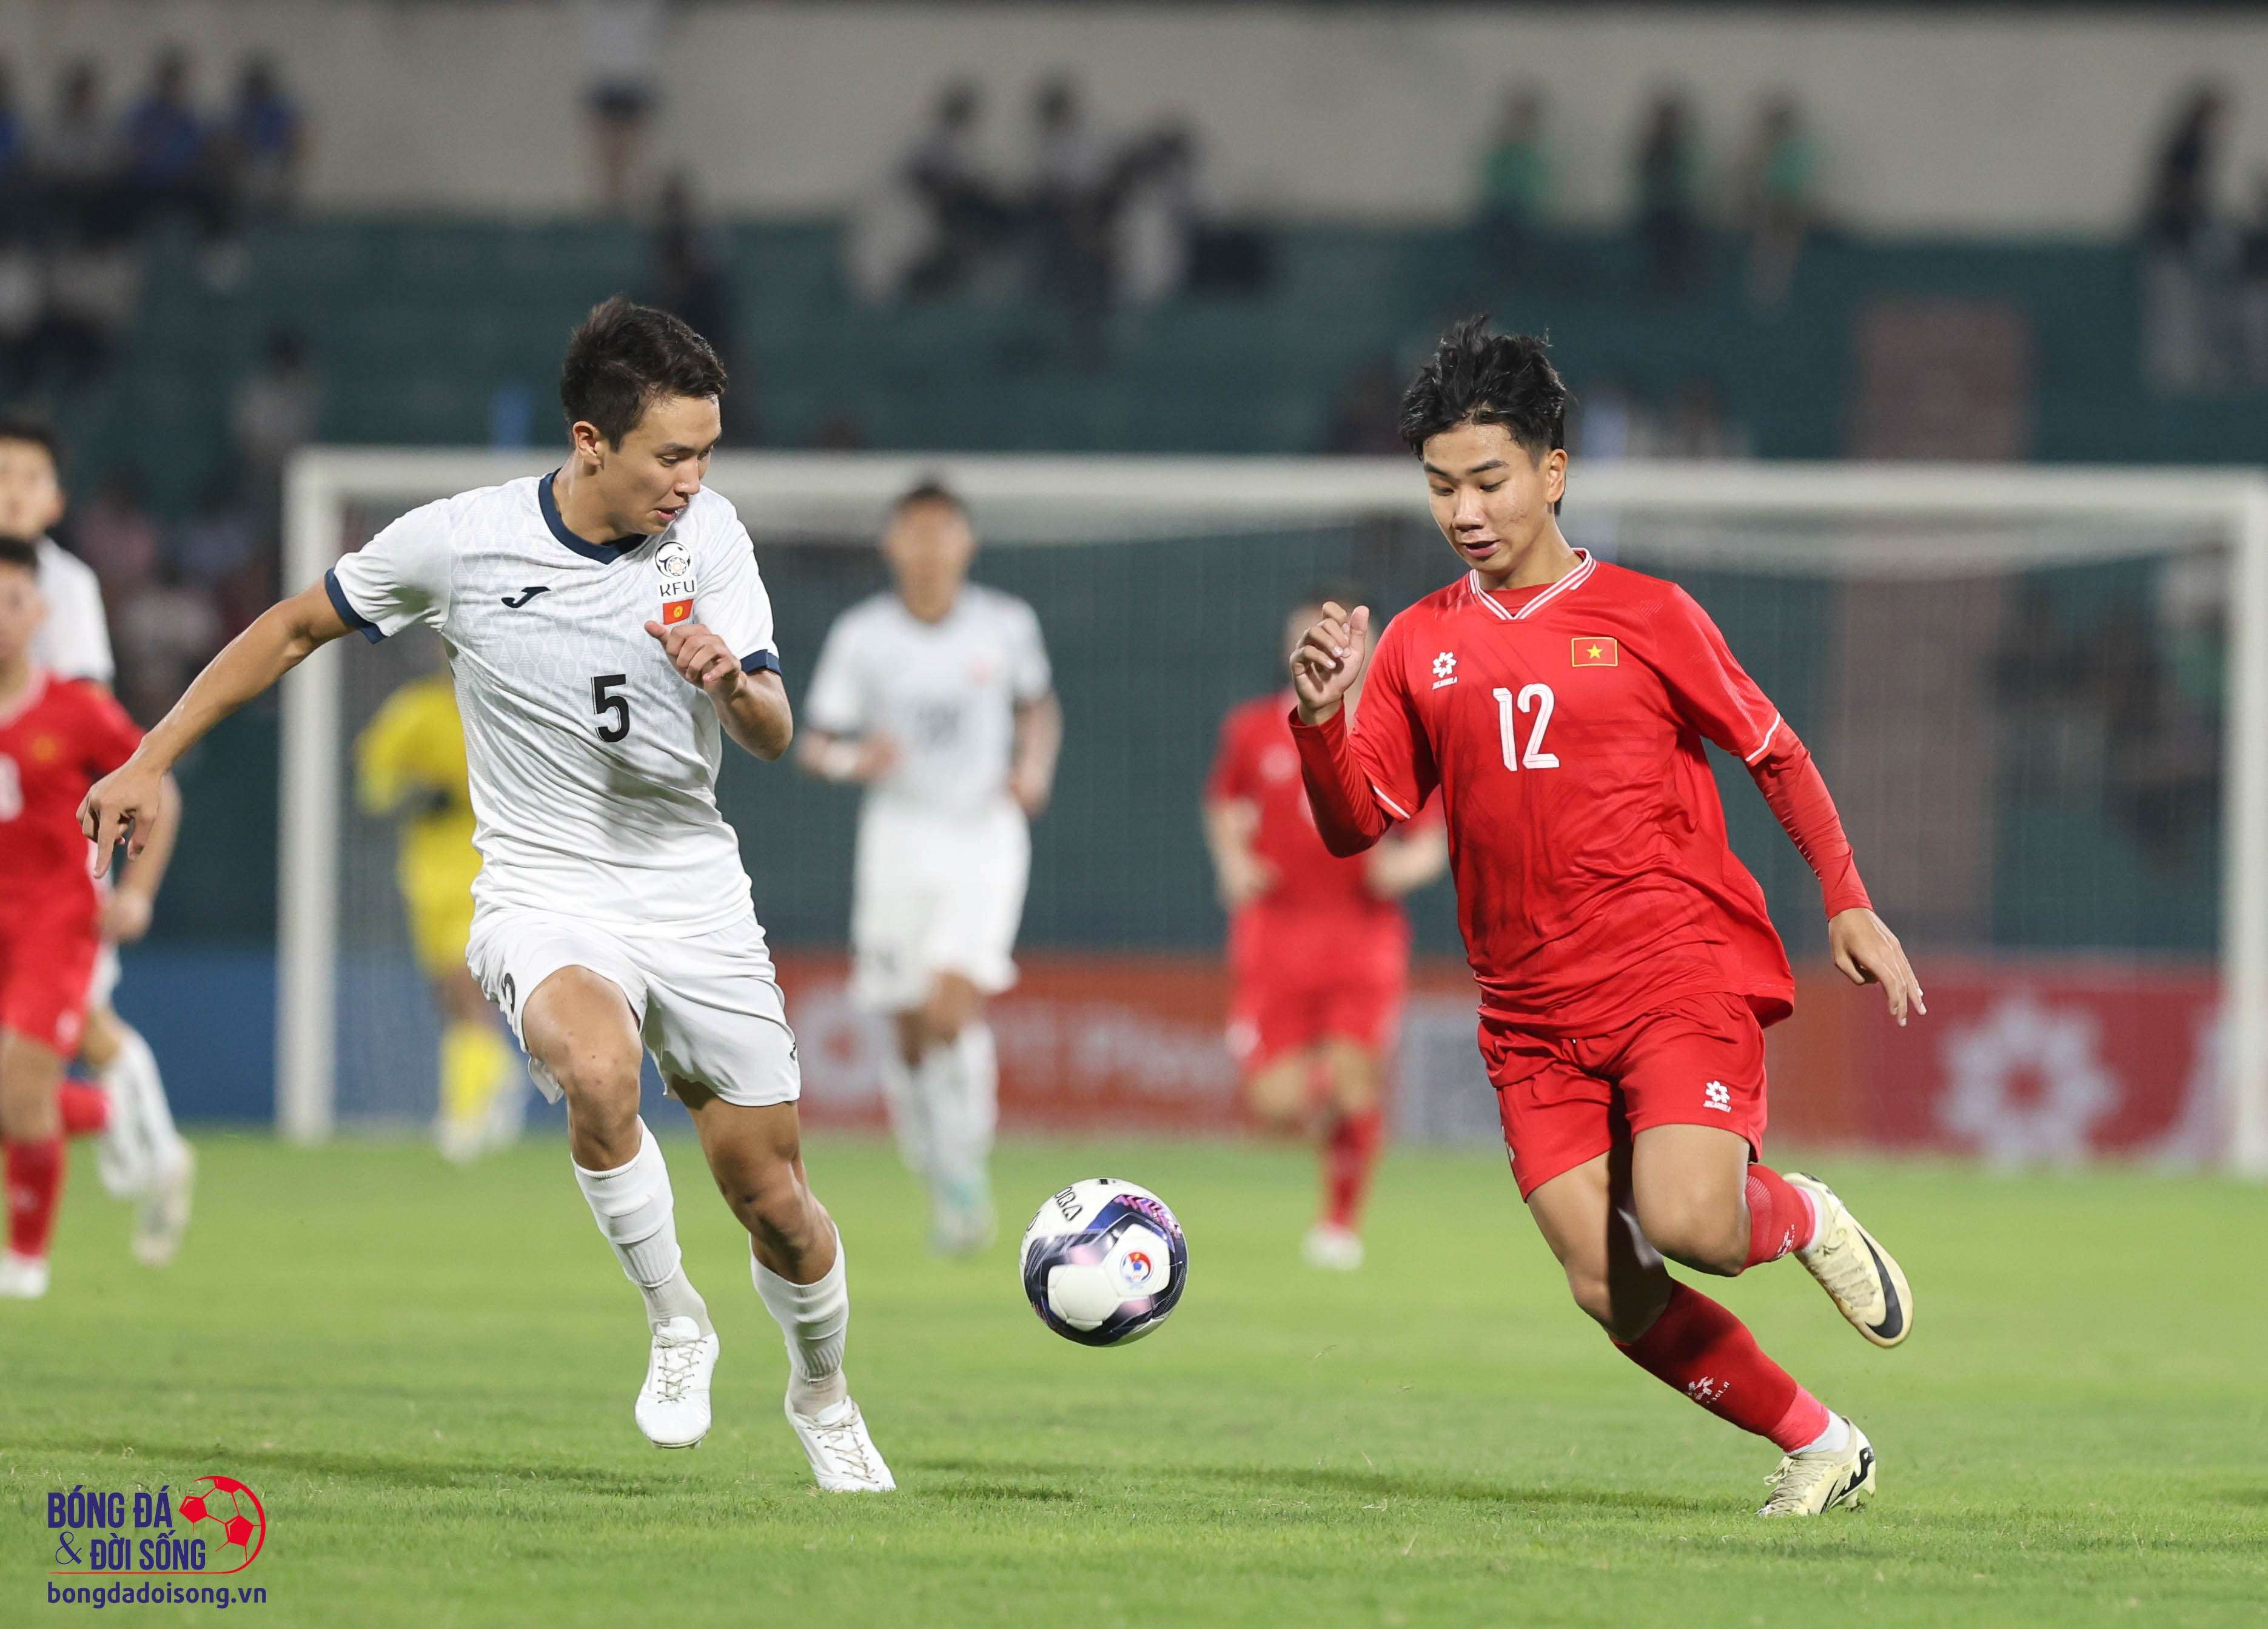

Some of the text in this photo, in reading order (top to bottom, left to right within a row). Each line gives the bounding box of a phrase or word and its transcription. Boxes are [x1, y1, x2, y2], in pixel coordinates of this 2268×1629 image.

[660, 579, 695, 597] KFU
[591, 673, 630, 743] 5
[1492, 683, 1560, 771] 12
